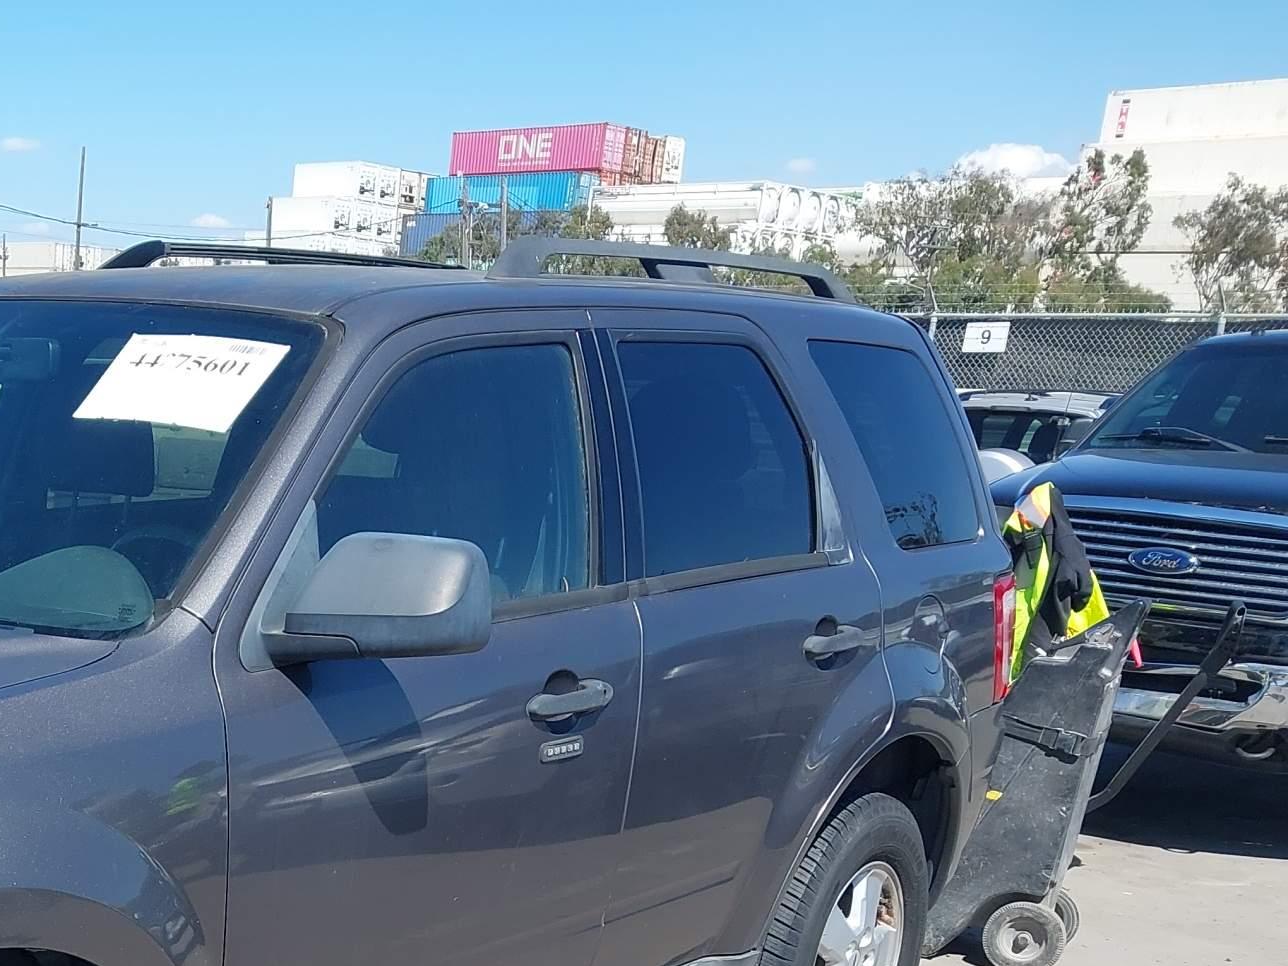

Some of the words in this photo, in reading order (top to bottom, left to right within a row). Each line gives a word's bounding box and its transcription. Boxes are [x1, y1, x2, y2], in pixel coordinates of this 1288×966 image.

[498, 132, 553, 161] ONE
[980, 329, 992, 345] 9
[1141, 550, 1182, 569] Ford
